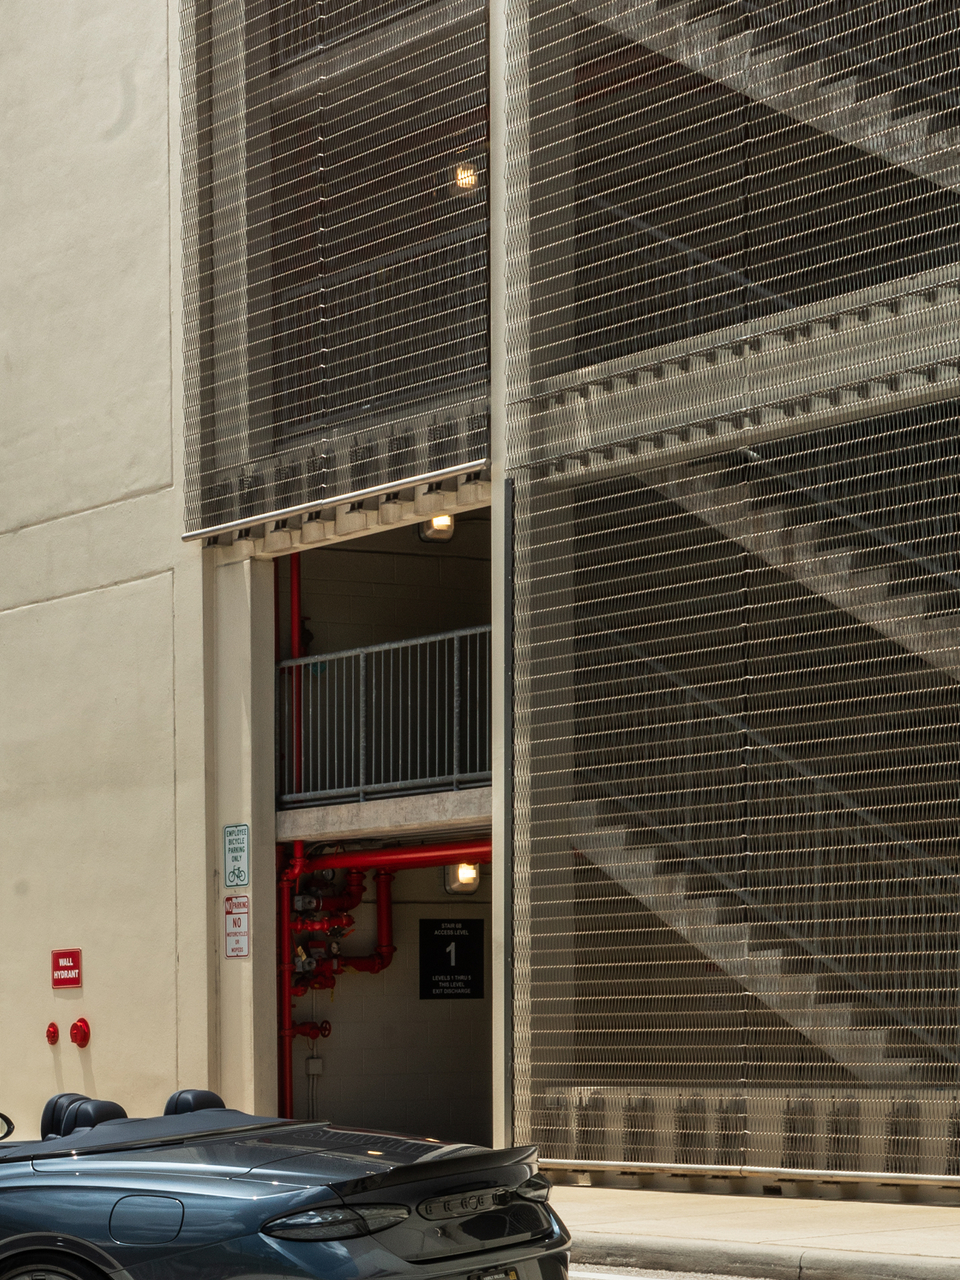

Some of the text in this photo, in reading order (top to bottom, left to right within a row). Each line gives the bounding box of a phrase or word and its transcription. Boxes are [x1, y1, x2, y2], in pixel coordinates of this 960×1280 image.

[226, 828, 247, 837] EMPLOYEE
[228, 837, 245, 846] BICYCLE
[228, 846, 245, 854] PARKING
[231, 855, 242, 863] ONLY
[226, 900, 248, 912] NO PARKING
[232, 917, 241, 928] NO
[445, 941, 456, 967] 1
[58, 957, 73, 966] WALL
[53, 969, 79, 979] HYDRANT
